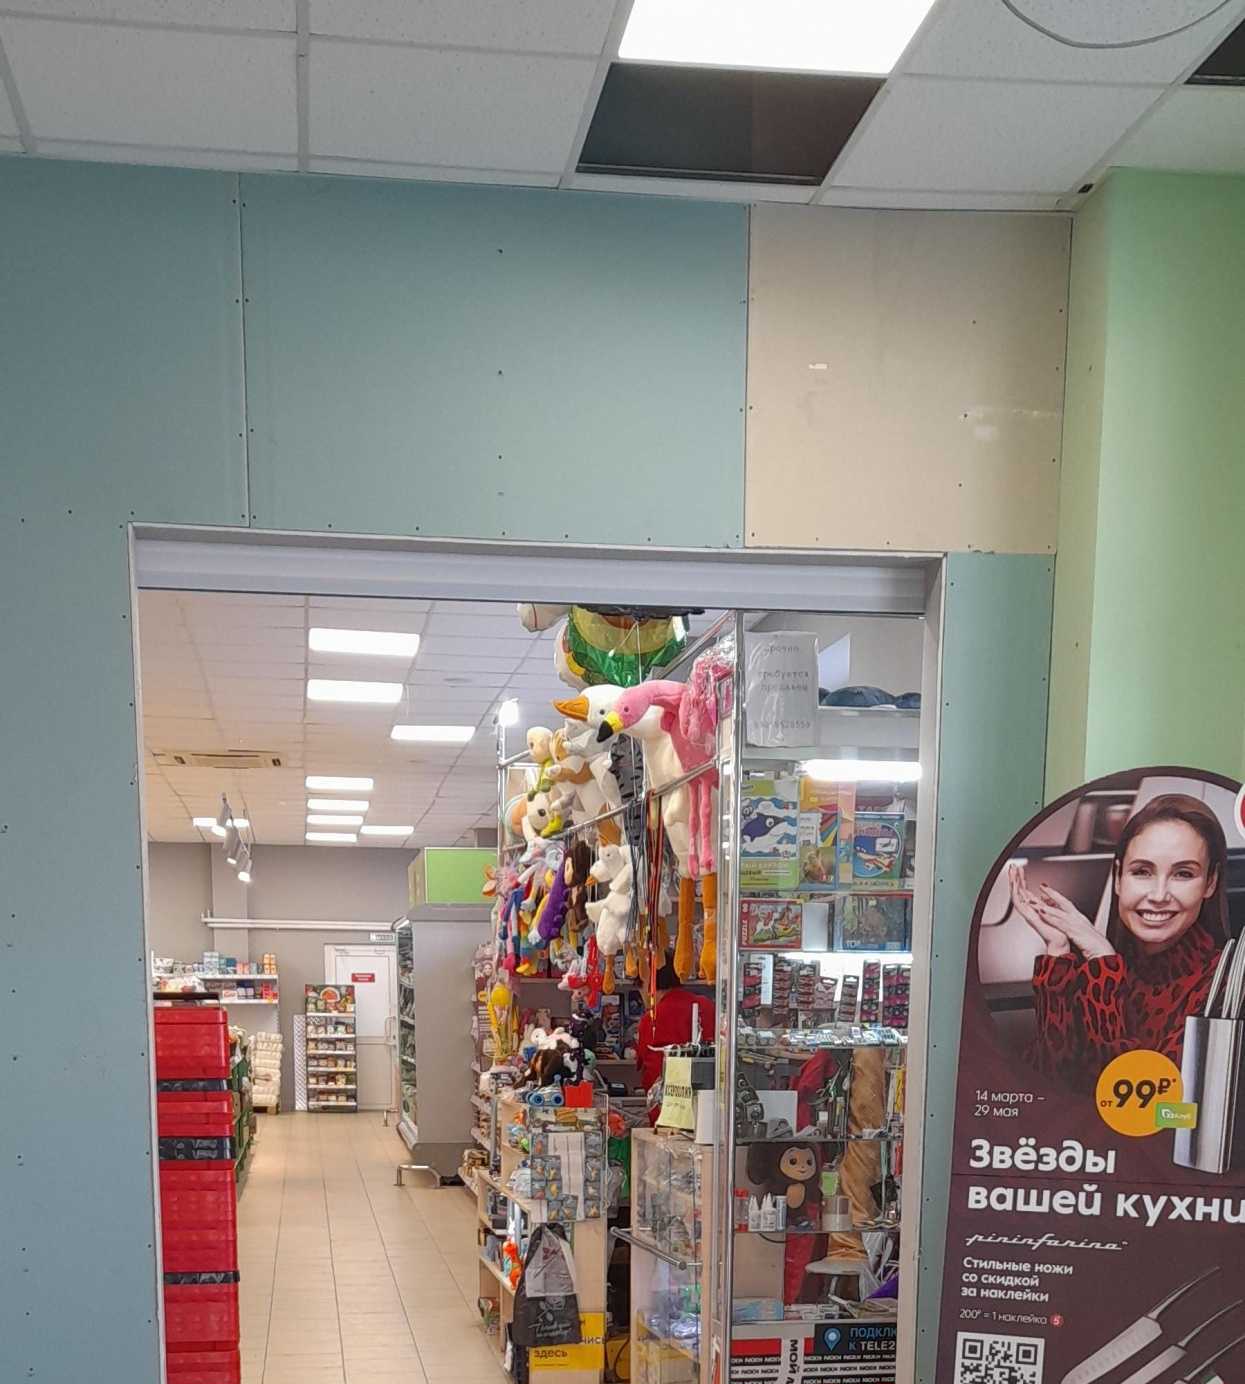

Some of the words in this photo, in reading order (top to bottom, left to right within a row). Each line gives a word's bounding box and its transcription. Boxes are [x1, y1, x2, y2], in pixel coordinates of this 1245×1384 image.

[976, 1090, 988, 1101] 14
[991, 1094, 1034, 1105] марта
[1100, 1100, 1113, 1108] от
[974, 1104, 990, 1117] 29
[993, 1107, 1019, 1118] мая
[969, 1137, 1116, 1174] Звёзды
[967, 1184, 1102, 1216] вашей
[1116, 1193, 1245, 1227] кухни
[963, 1256, 1031, 1272] Стильные
[1035, 1264, 1074, 1275] ножи
[962, 1273, 978, 1283] со
[981, 1274, 1040, 1288] скидкой
[961, 1287, 977, 1297] за
[980, 1288, 1050, 1303] наклейки
[998, 1314, 1048, 1325] наклейка
[860, 1341, 896, 1351] TELE2
[534, 1349, 568, 1360] здесь
[788, 1339, 800, 1375] МОЙ
